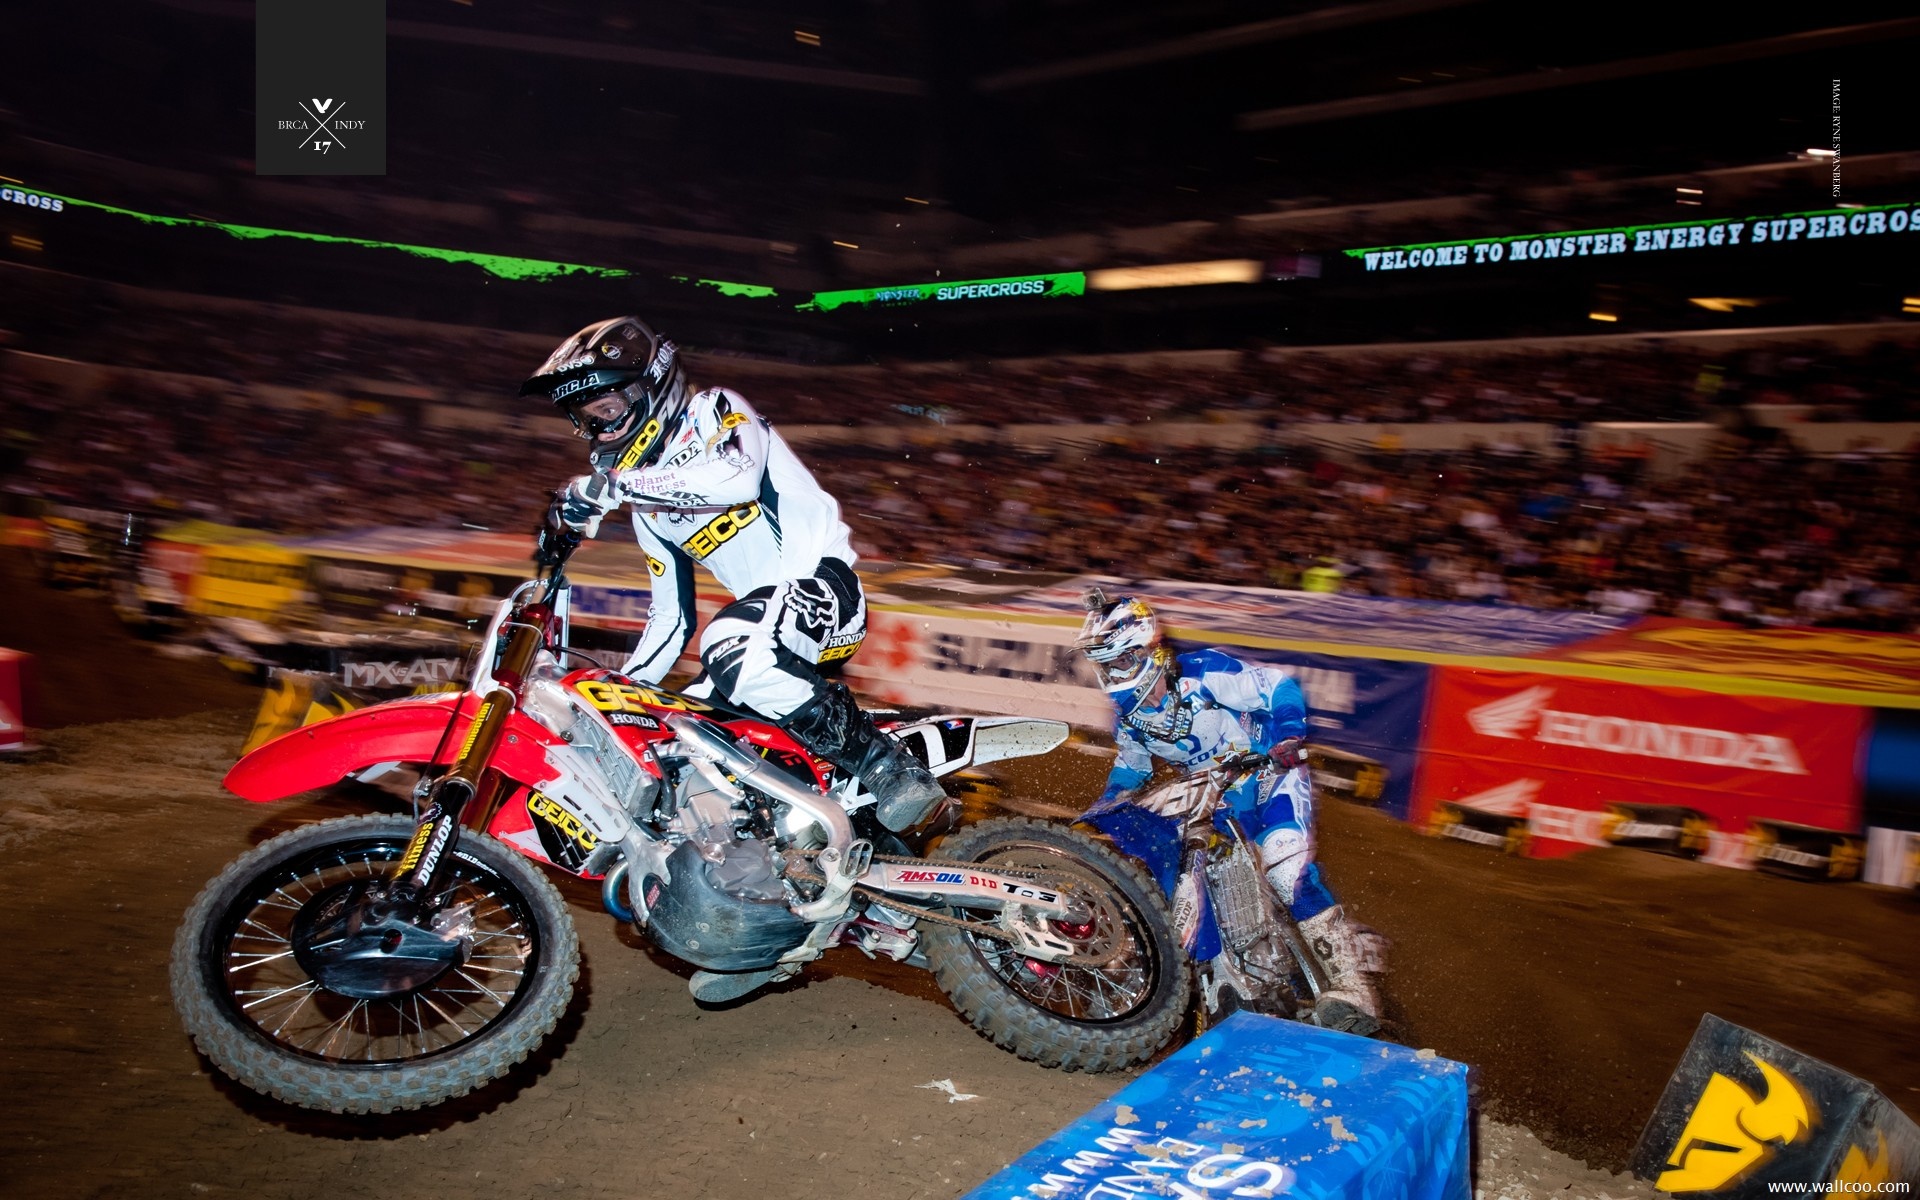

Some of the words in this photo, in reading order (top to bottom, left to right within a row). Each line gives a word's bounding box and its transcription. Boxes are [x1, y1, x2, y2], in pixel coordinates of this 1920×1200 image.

[1, 188, 64, 212] CROSS
[1364, 245, 1469, 271] WELCOME
[1474, 243, 1504, 263] TO
[1509, 232, 1628, 261] MONSTER
[1634, 222, 1745, 252] ENERGY
[936, 280, 1045, 301] SUPERCROSS
[551, 373, 601, 402] ARCIA
[663, 440, 704, 471] NDA
[634, 472, 676, 489] planet
[640, 479, 687, 495] fitness
[575, 680, 714, 714] GEICO
[610, 713, 660, 730] HONDA
[1533, 707, 1810, 775] HONDA
[526, 791, 602, 851] GEICO
[402, 822, 434, 870] fitness
[418, 814, 453, 887] DUNLOP
[896, 870, 964, 885] AMSOIL
